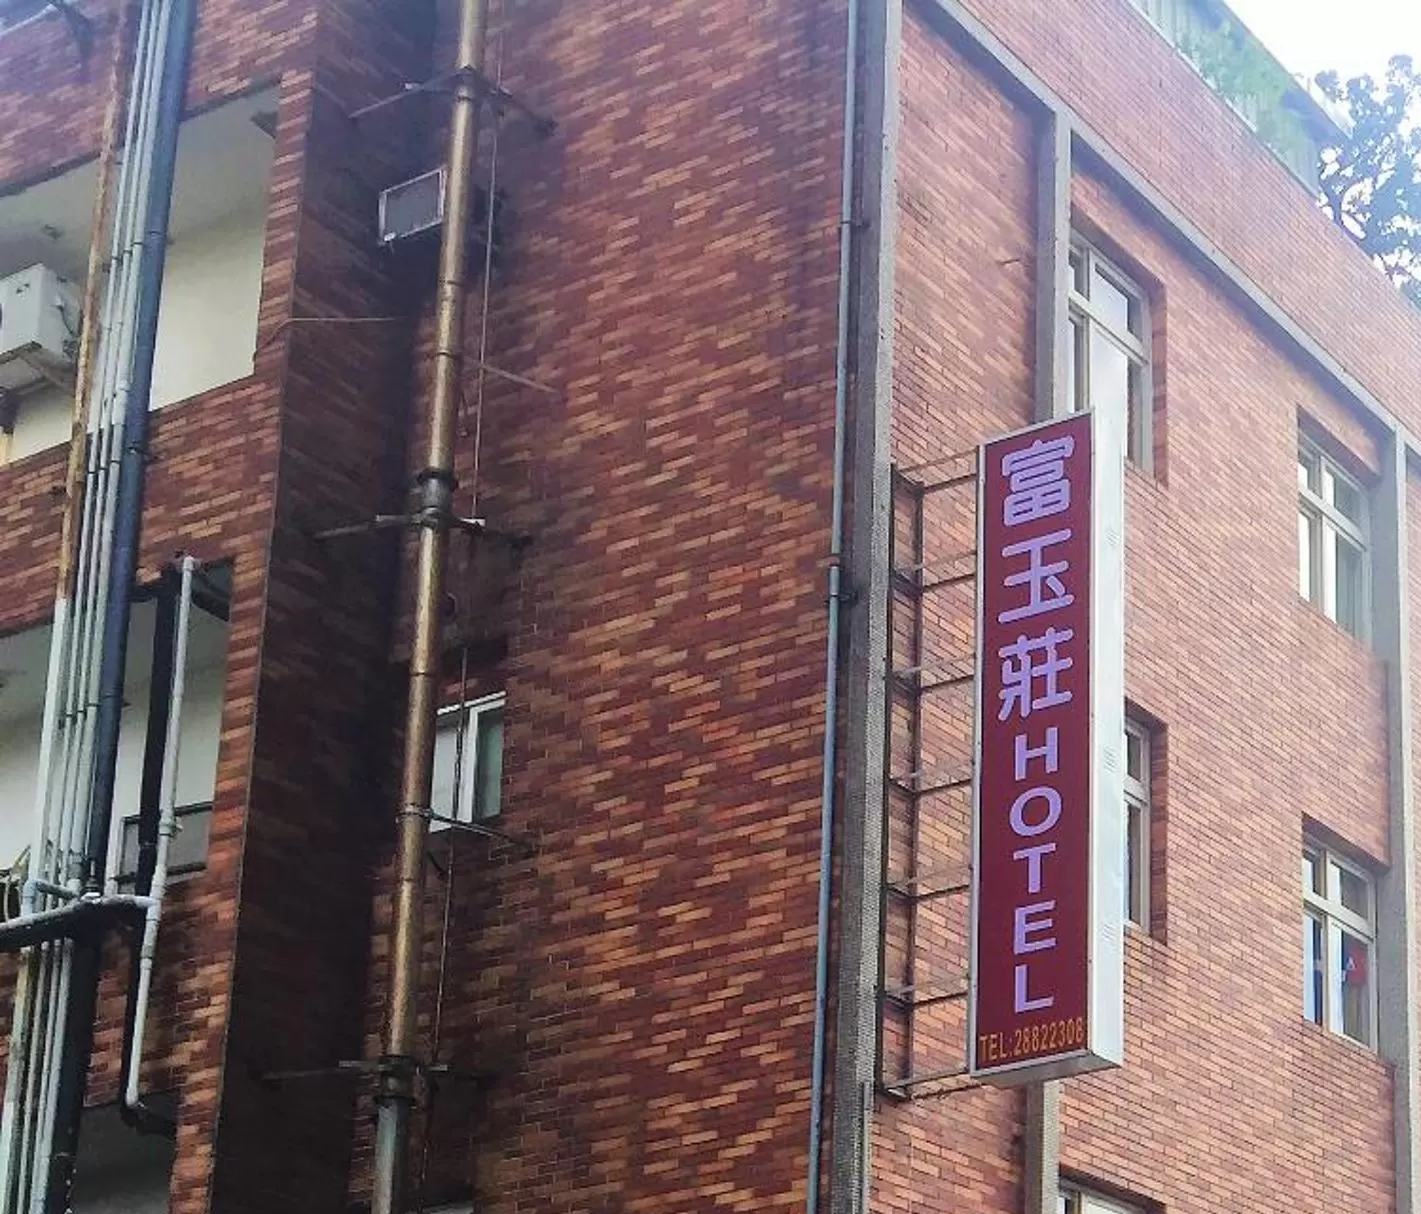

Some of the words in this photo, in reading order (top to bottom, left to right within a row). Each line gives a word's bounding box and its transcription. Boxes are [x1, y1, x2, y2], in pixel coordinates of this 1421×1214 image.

[999, 435, 1075, 721] 富玉莊
[1009, 727, 1062, 1013] HOTEL
